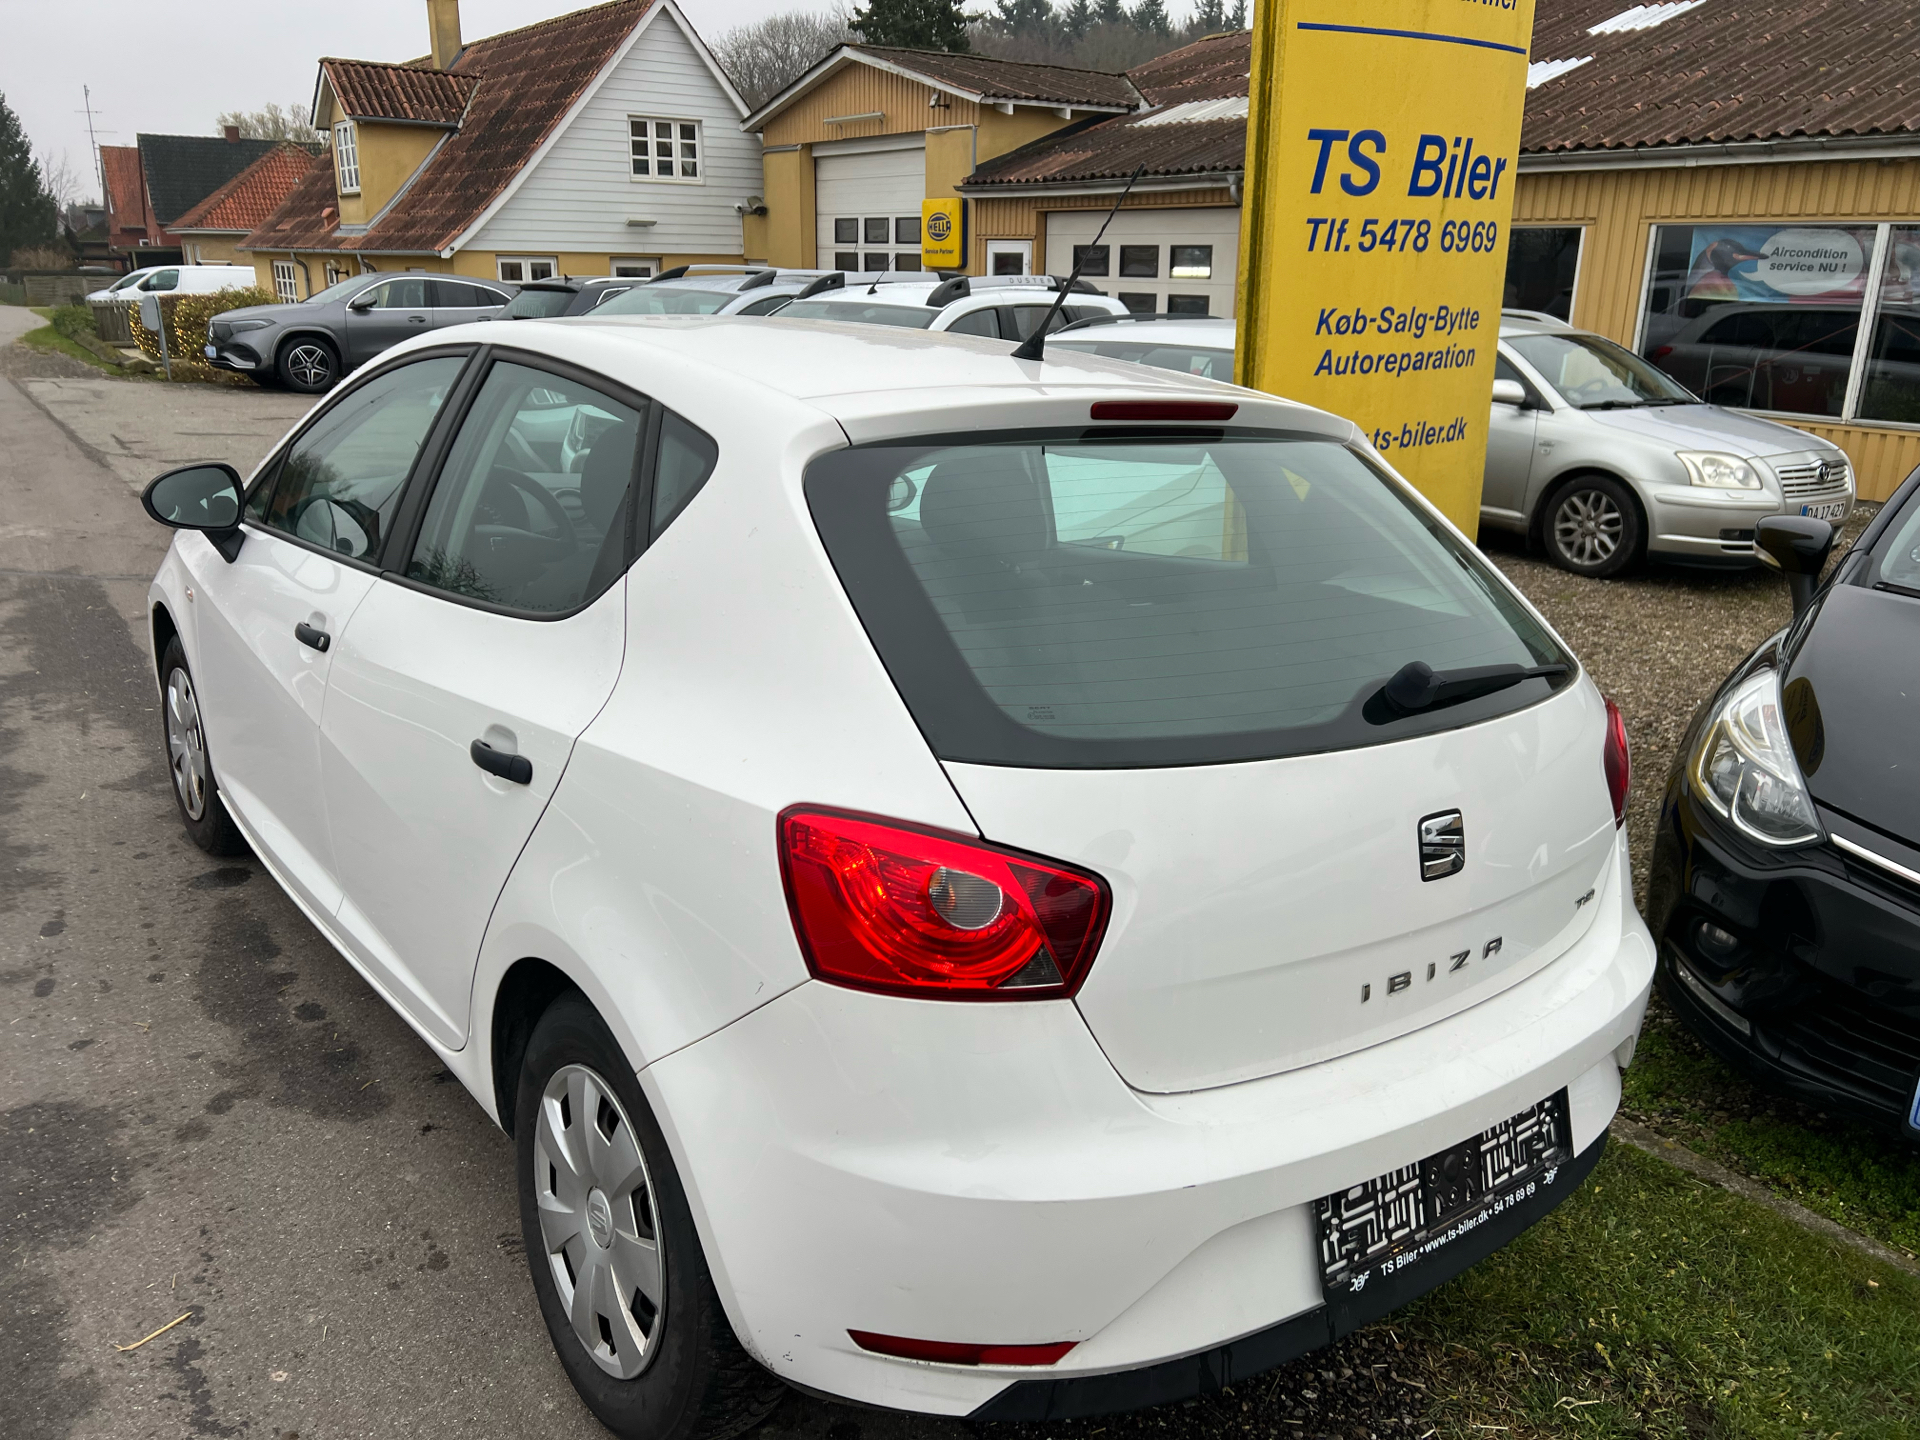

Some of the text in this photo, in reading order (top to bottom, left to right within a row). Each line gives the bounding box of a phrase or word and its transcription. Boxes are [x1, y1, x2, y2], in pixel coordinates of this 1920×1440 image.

[1307, 128, 1507, 200] TS Biler
[928, 220, 952, 233] HELLA
[1306, 218, 1498, 253] Tlf. 5478 6969
[1769, 262, 1815, 272] service
[1818, 262, 1839, 273] NU
[1770, 246, 1848, 259] Aircondition
[1009, 277, 1053, 285] DUSTER
[1315, 305, 1480, 339] Køb-Salg-Bytte
[1314, 343, 1475, 377] Autoreparation
[1366, 417, 1468, 450] ts-biler.dk
[1361, 936, 1503, 1004] IBIZA
[1381, 1181, 1536, 1276] TS Biler www.ts-biler.dk 54 78 69 69
